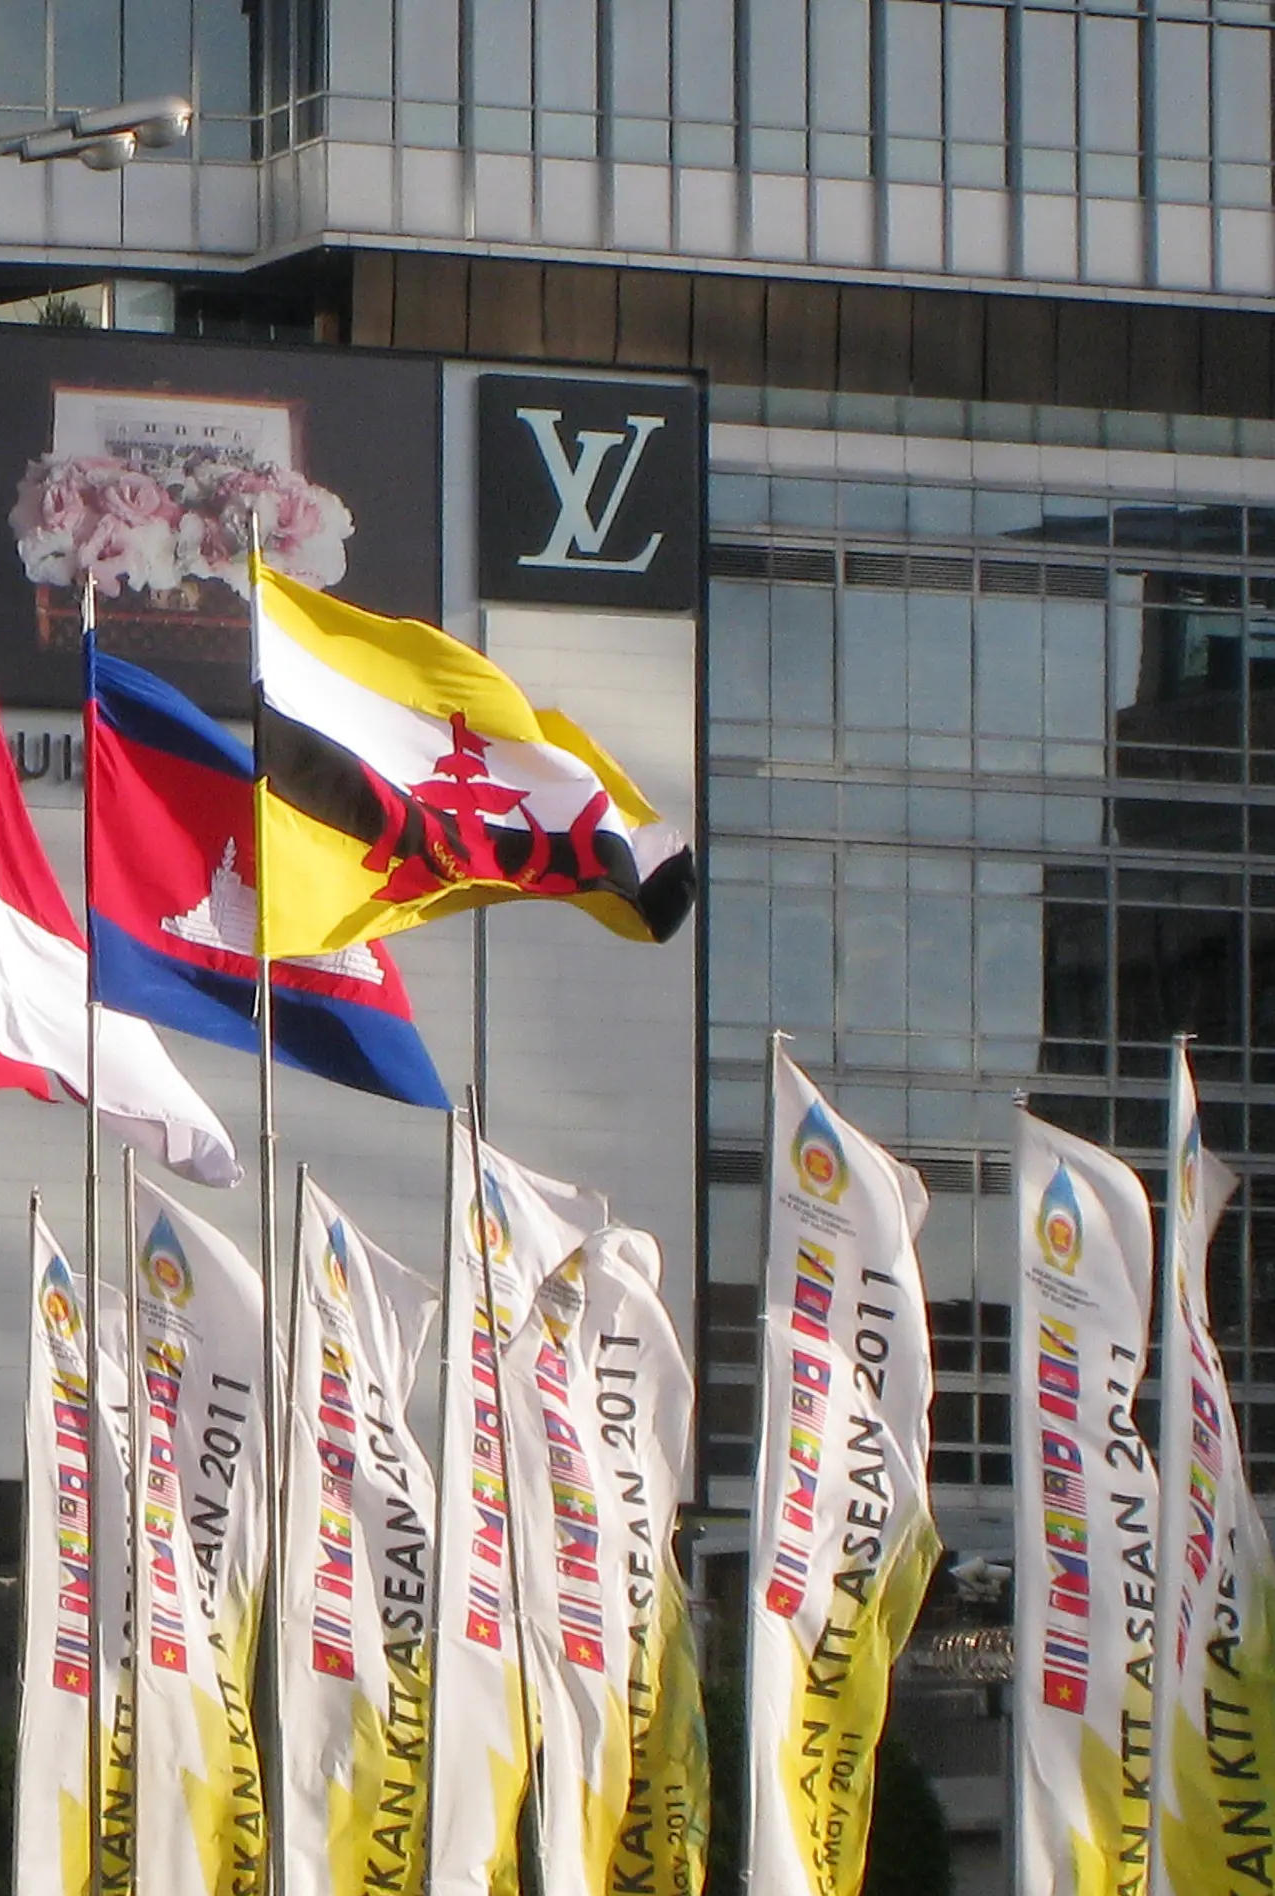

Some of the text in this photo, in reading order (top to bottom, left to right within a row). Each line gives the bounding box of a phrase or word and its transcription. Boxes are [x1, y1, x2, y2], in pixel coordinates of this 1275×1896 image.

[595, 1331, 641, 1451] 2011
[853, 1268, 899, 1401] 2011
[199, 1371, 251, 1490] 2011
[1104, 1343, 1145, 1473] 2011
[834, 1413, 892, 1606] ASEAN
[382, 1497, 427, 1676] ASEAN
[1110, 1492, 1156, 1692] ASEAN
[806, 1618, 858, 1700] KTT
[385, 1681, 425, 1763] KTT
[828, 1731, 863, 1793] 2011
[1203, 1687, 1260, 1780] KTT
[665, 1783, 687, 1845] 2011
